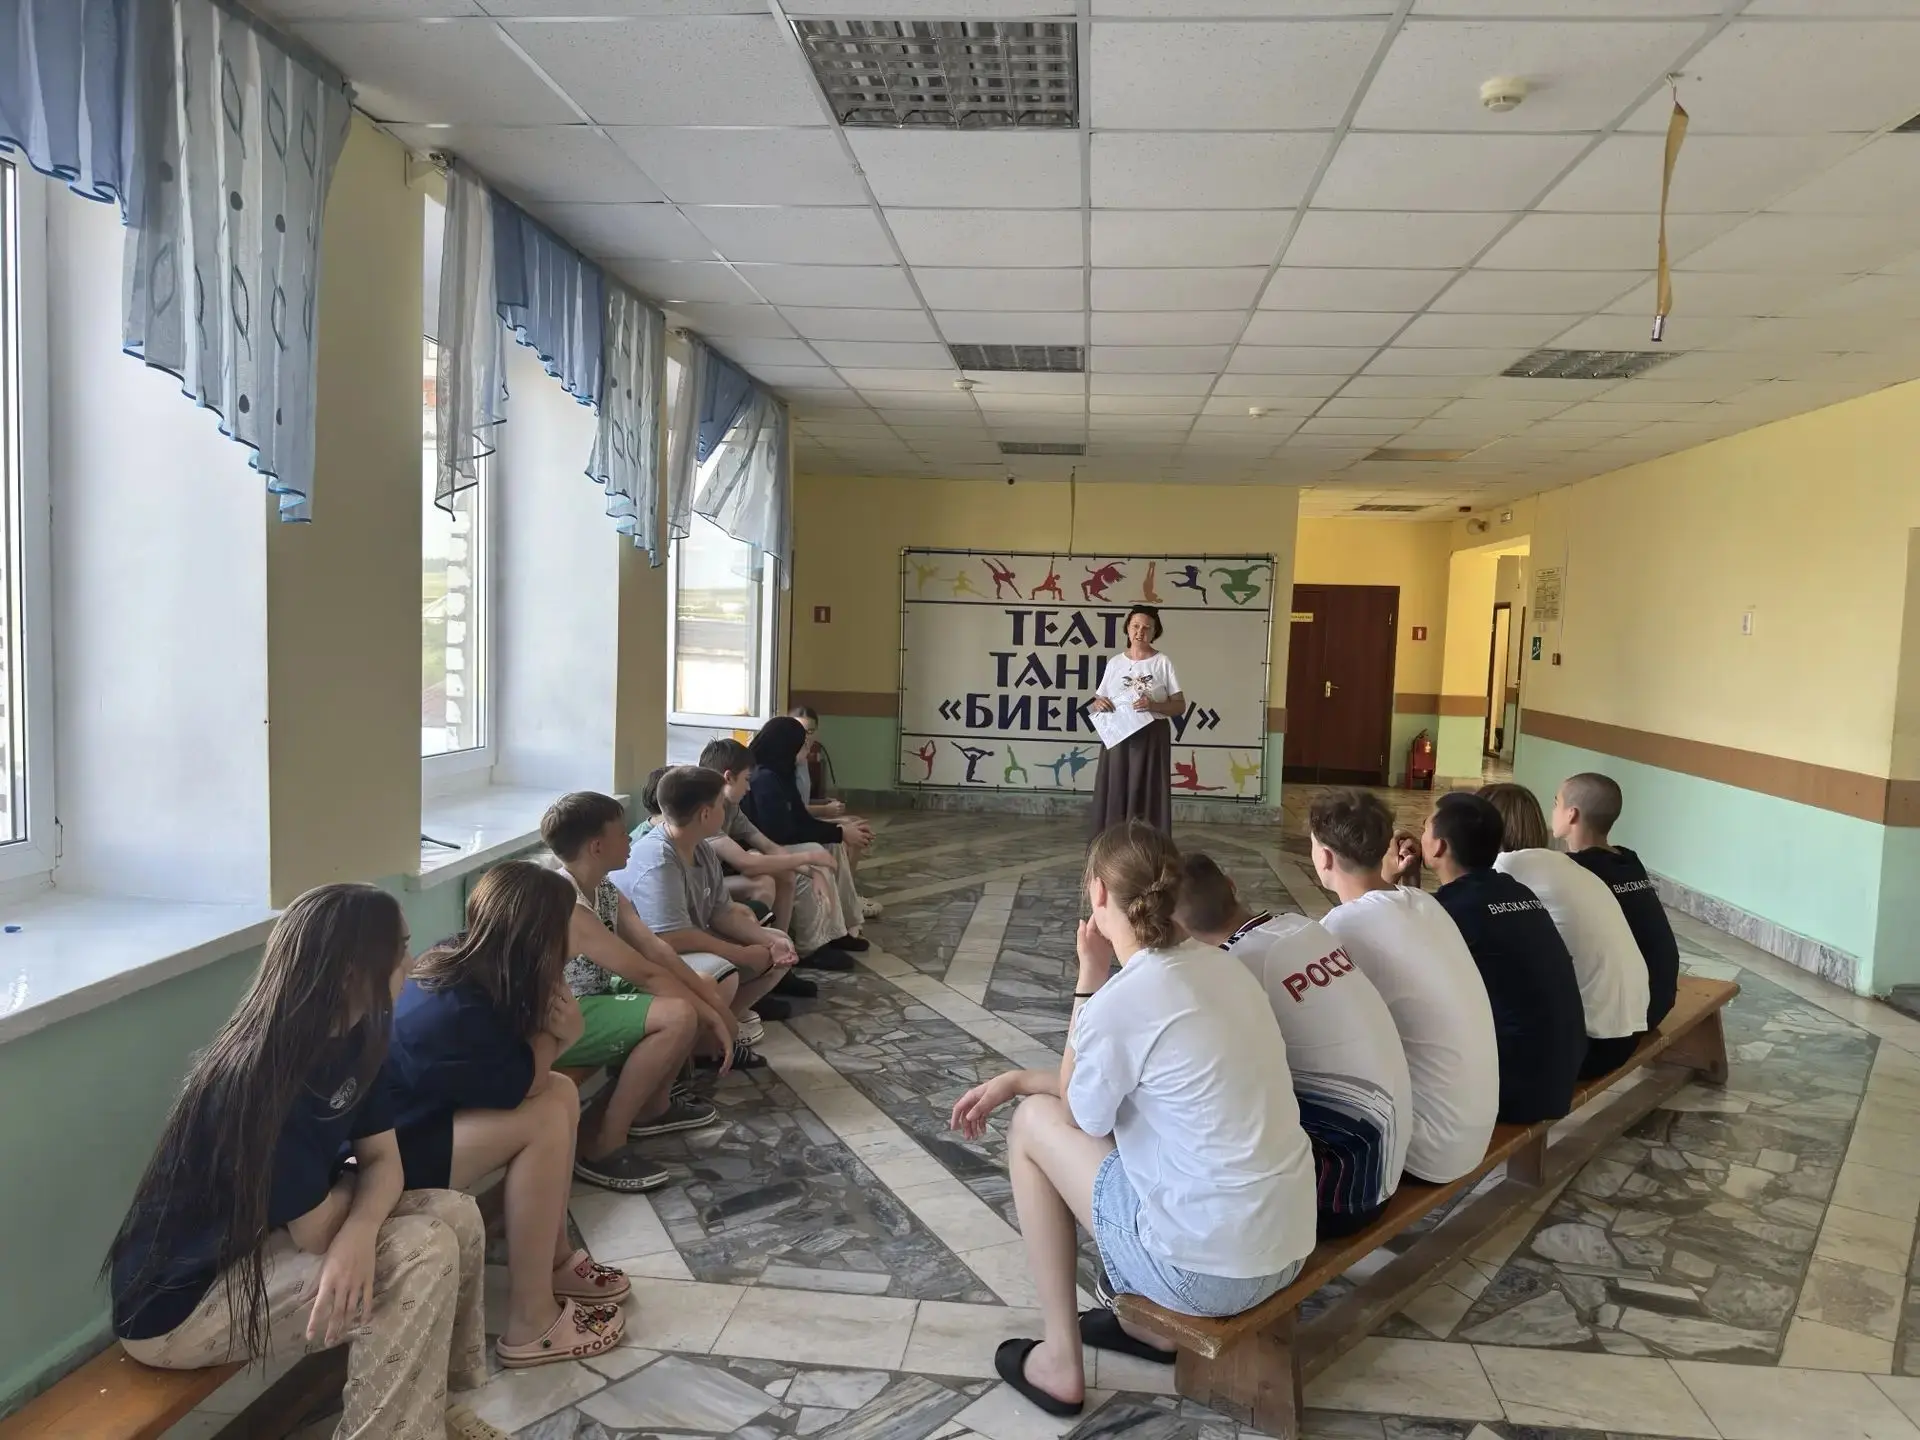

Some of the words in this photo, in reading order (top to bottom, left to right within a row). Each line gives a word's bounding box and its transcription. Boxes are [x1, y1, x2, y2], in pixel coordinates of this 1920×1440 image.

[1004, 609, 1126, 649] ТЕАТ
[938, 692, 1221, 743] «БИЕКУ»
[608, 1178, 645, 1189] crocs
[571, 1330, 619, 1356] crocs
